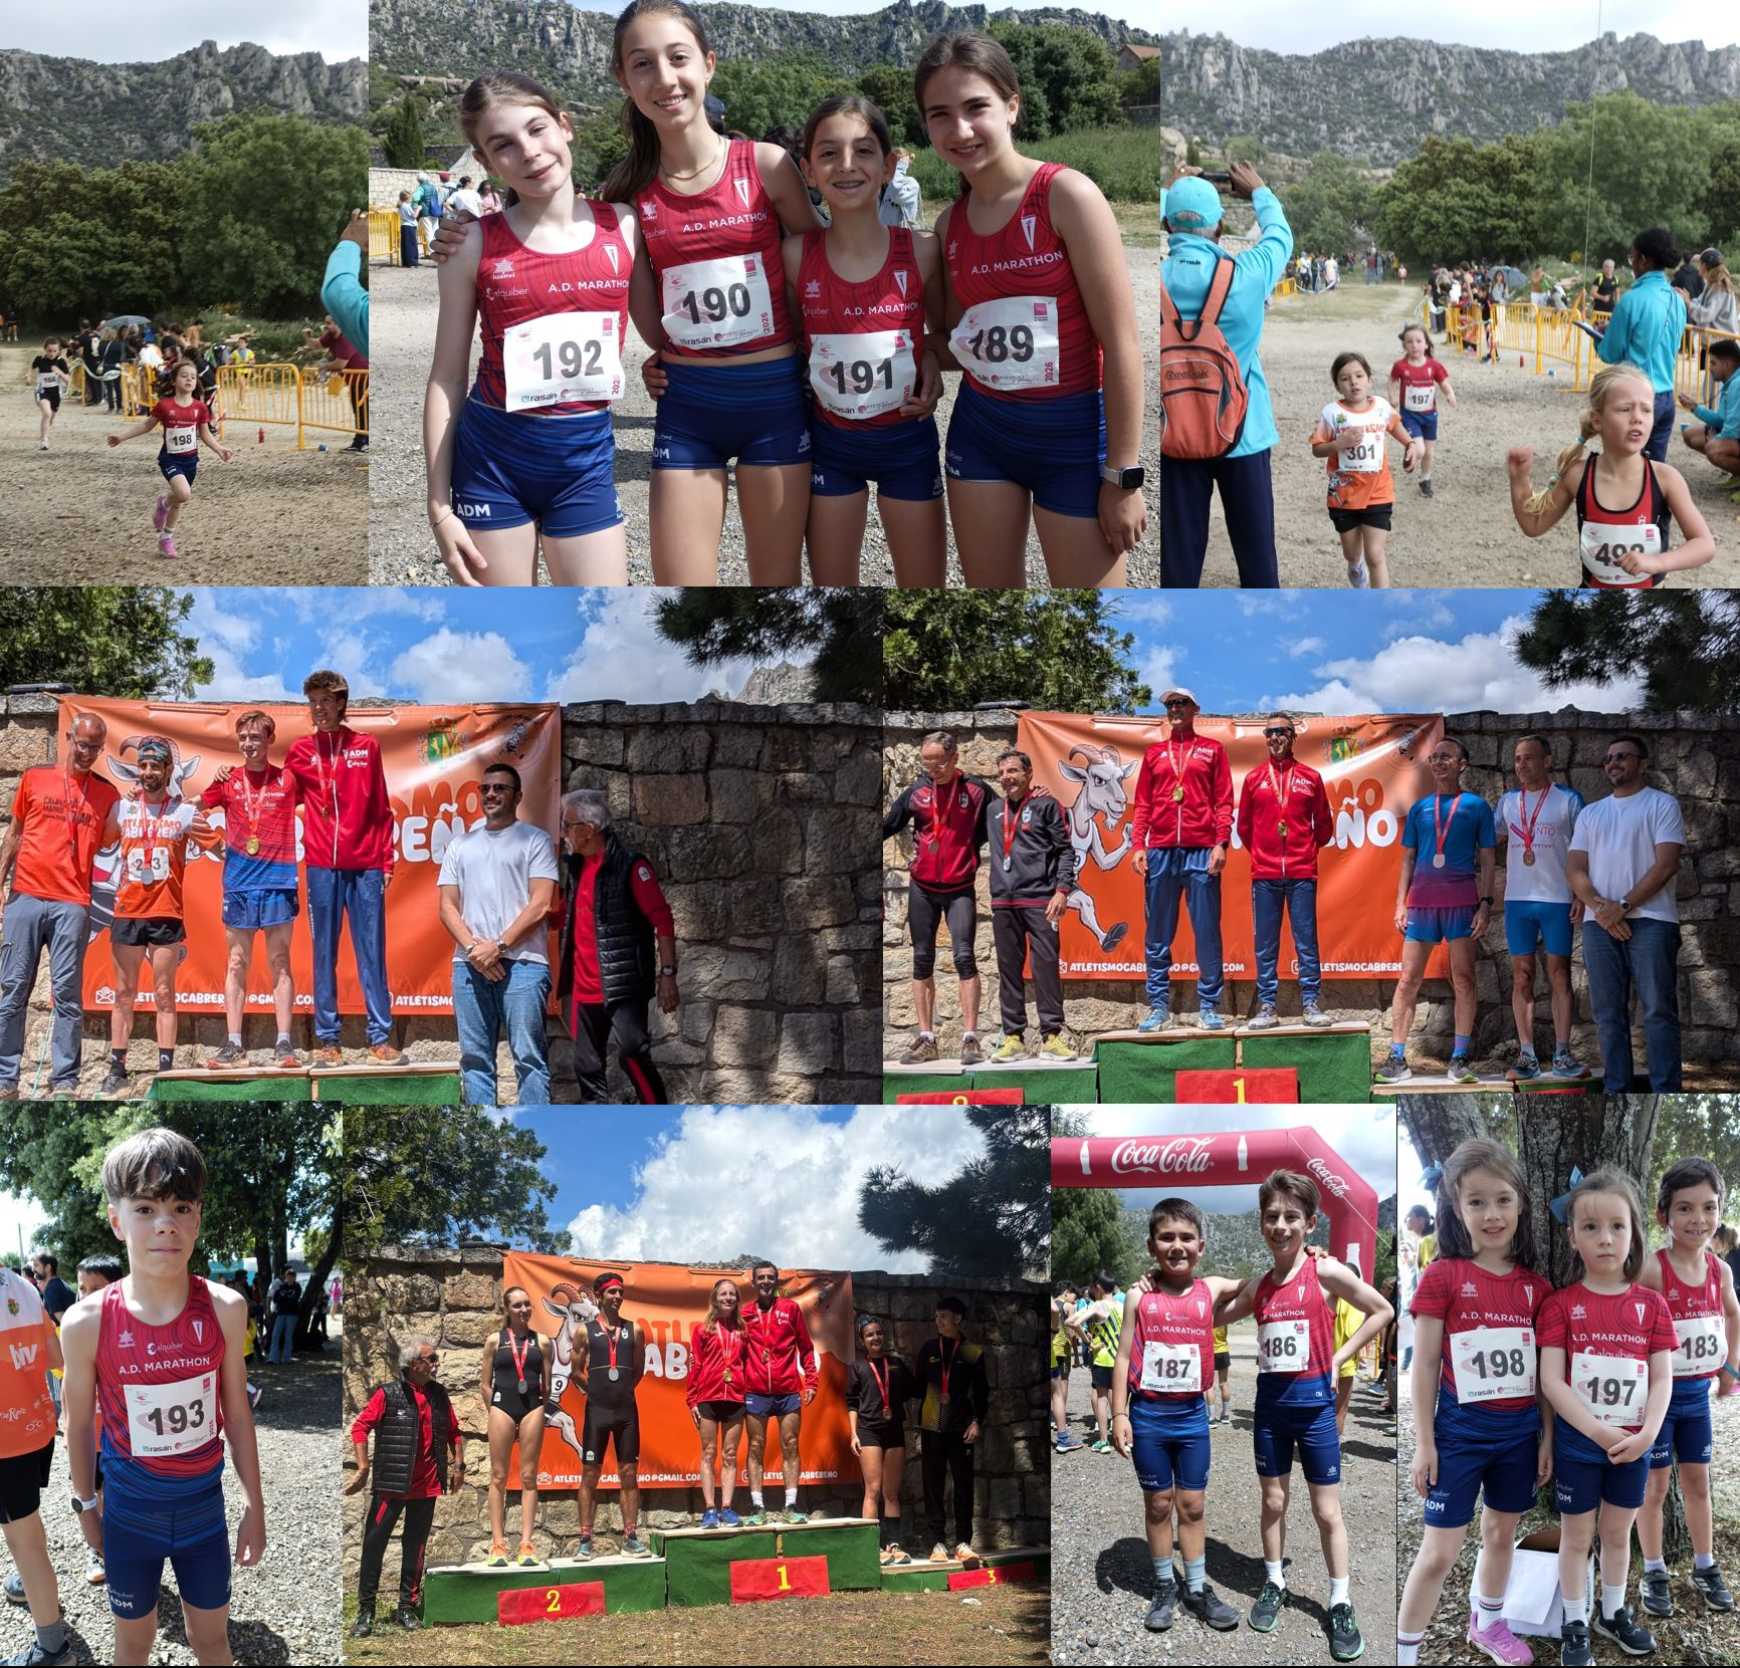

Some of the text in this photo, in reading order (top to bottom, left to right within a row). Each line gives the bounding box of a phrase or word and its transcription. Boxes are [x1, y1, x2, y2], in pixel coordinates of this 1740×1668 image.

[682, 222, 707, 233] A.D.
[970, 250, 1064, 275] A.D. MARATHON
[548, 279, 629, 293] A.D. MARATHO
[682, 283, 751, 326] 190
[843, 306, 865, 316] A.D.
[968, 324, 1035, 363] 189
[532, 339, 605, 381] 192
[830, 358, 893, 394] 191
[173, 434, 192, 446] 198
[652, 447, 670, 459] DM
[1347, 444, 1375, 460] 301
[457, 503, 491, 517] ADM
[135, 857, 161, 871] 23
[1111, 1136, 1216, 1174] Coca-Cola
[1461, 1311, 1481, 1320] A.D.
[1162, 1325, 1206, 1336] MARATHON
[1592, 1333, 1647, 1345] MARATHON
[1264, 1336, 1297, 1358] 186
[1680, 1334, 1718, 1360] 183
[118, 1356, 210, 1375] A.D. MARATHON
[1154, 1357, 1192, 1379] 187
[1471, 1348, 1525, 1379] 198
[555, 1380, 563, 1391] 9
[1587, 1376, 1637, 1407] 197
[147, 1399, 205, 1436] 193
[776, 1566, 792, 1590] 1
[986, 1569, 996, 1583] 3
[545, 1590, 561, 1612] 2
